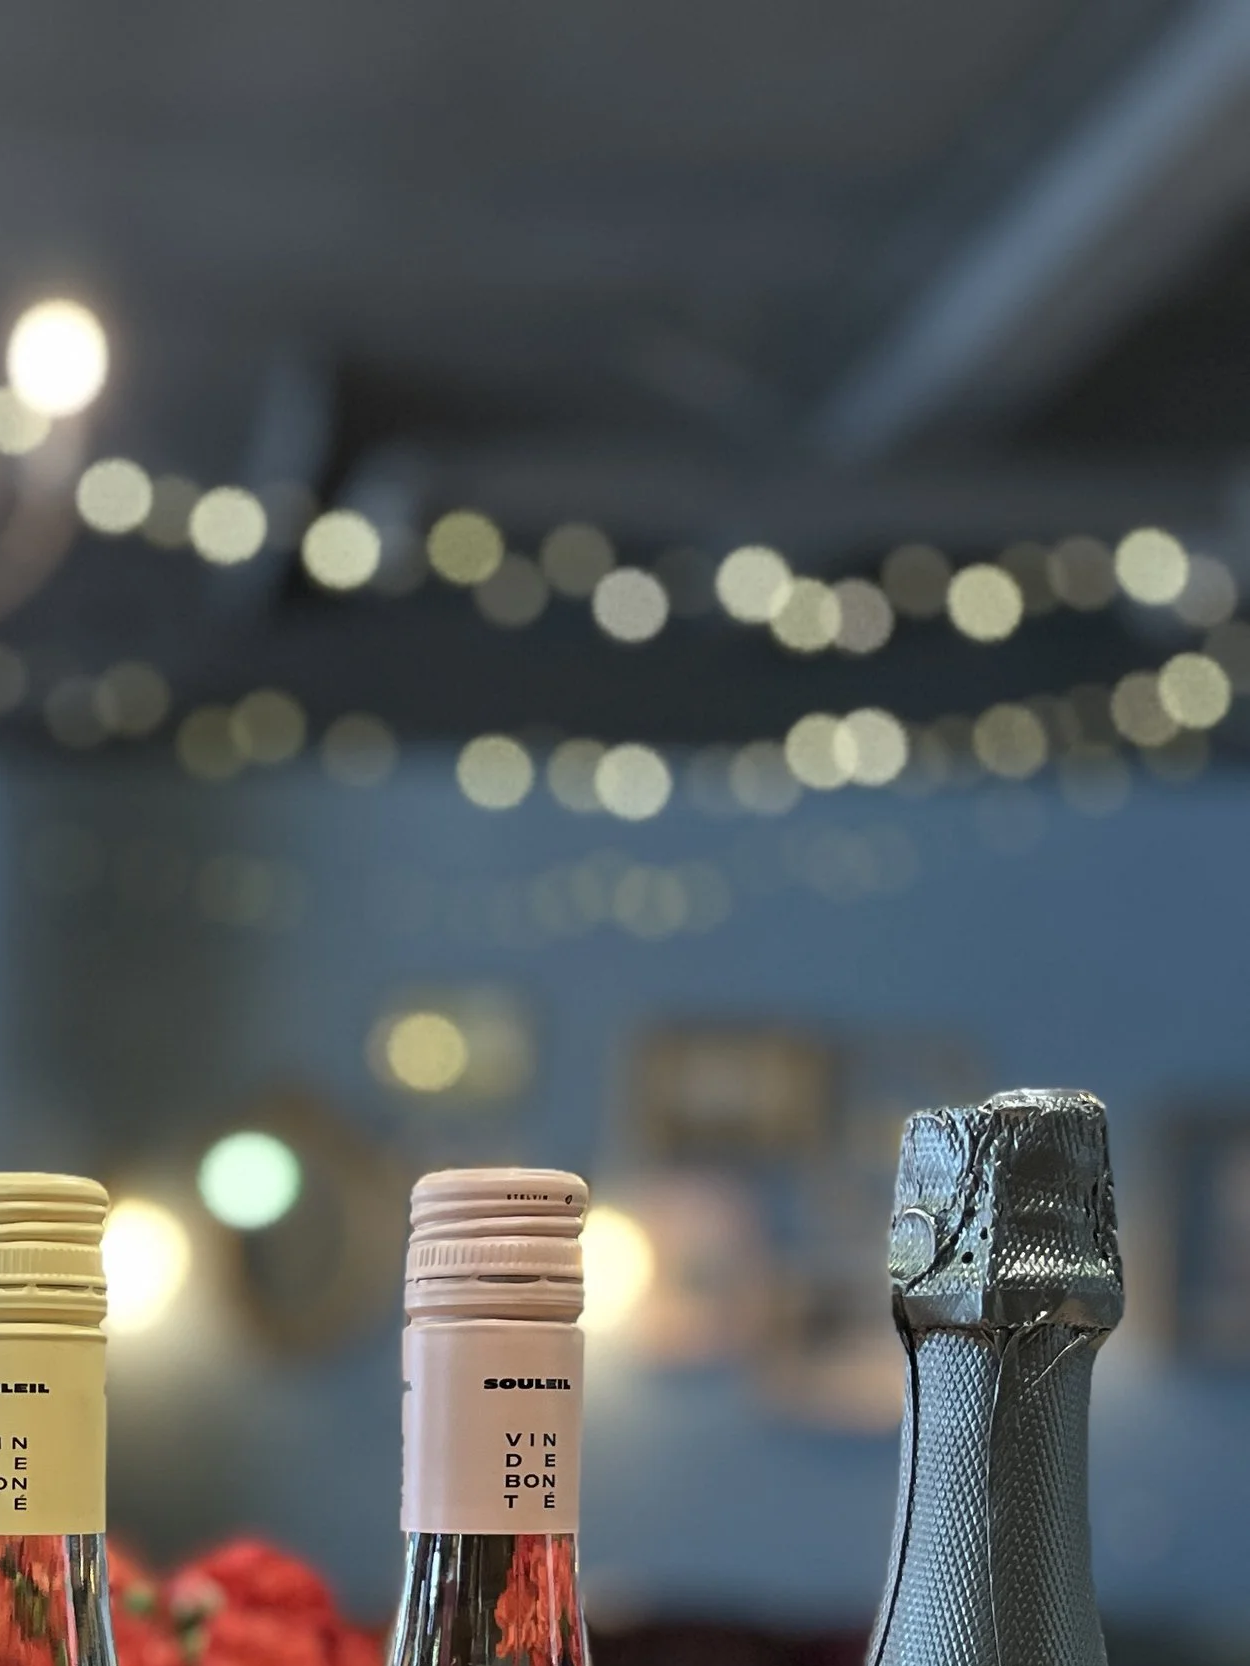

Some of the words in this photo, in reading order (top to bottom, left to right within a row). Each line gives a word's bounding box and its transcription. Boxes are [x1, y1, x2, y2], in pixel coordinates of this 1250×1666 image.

[483, 1378, 571, 1390] SOULEIL
[505, 1433, 556, 1447] VIN
[505, 1474, 556, 1488] BON
